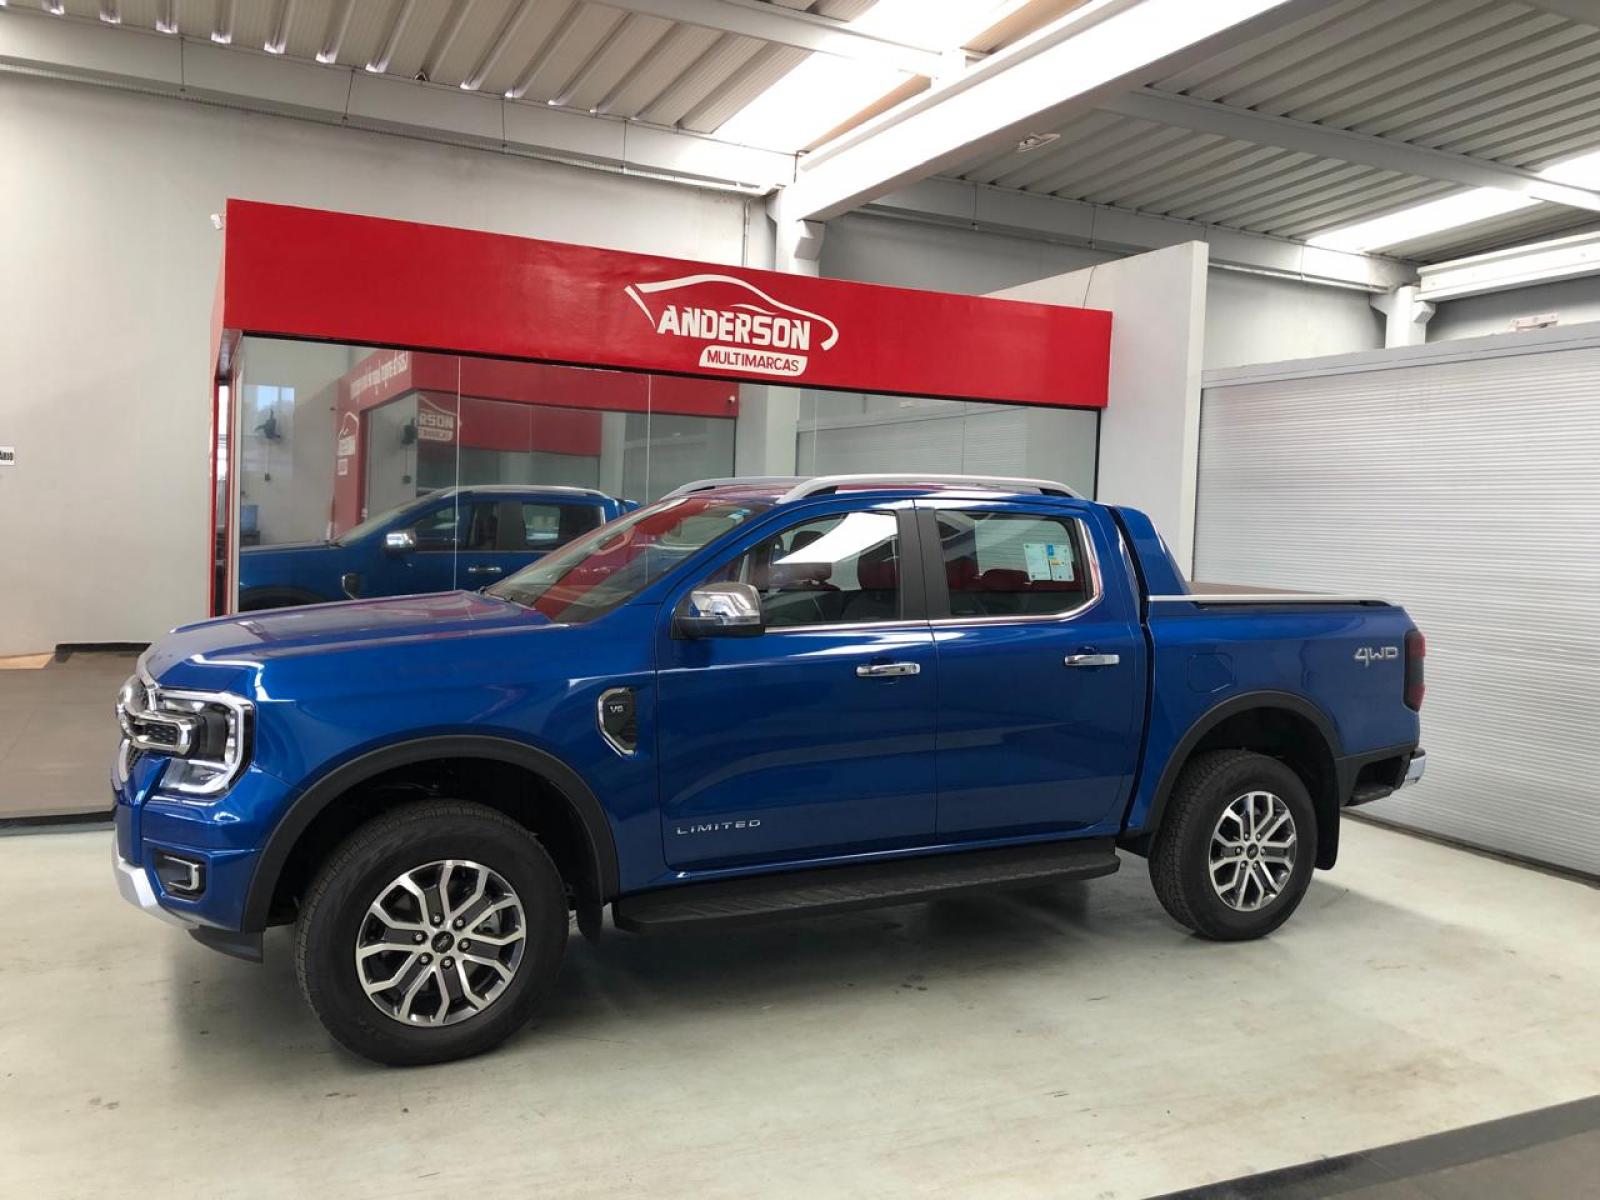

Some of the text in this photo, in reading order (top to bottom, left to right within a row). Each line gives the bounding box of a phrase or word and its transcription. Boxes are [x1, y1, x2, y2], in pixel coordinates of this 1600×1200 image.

[656, 304, 811, 351] ANDERSON
[706, 349, 800, 372] MULTIMARCAS
[1354, 646, 1399, 667] 4WD
[676, 819, 761, 835] LIMITED
